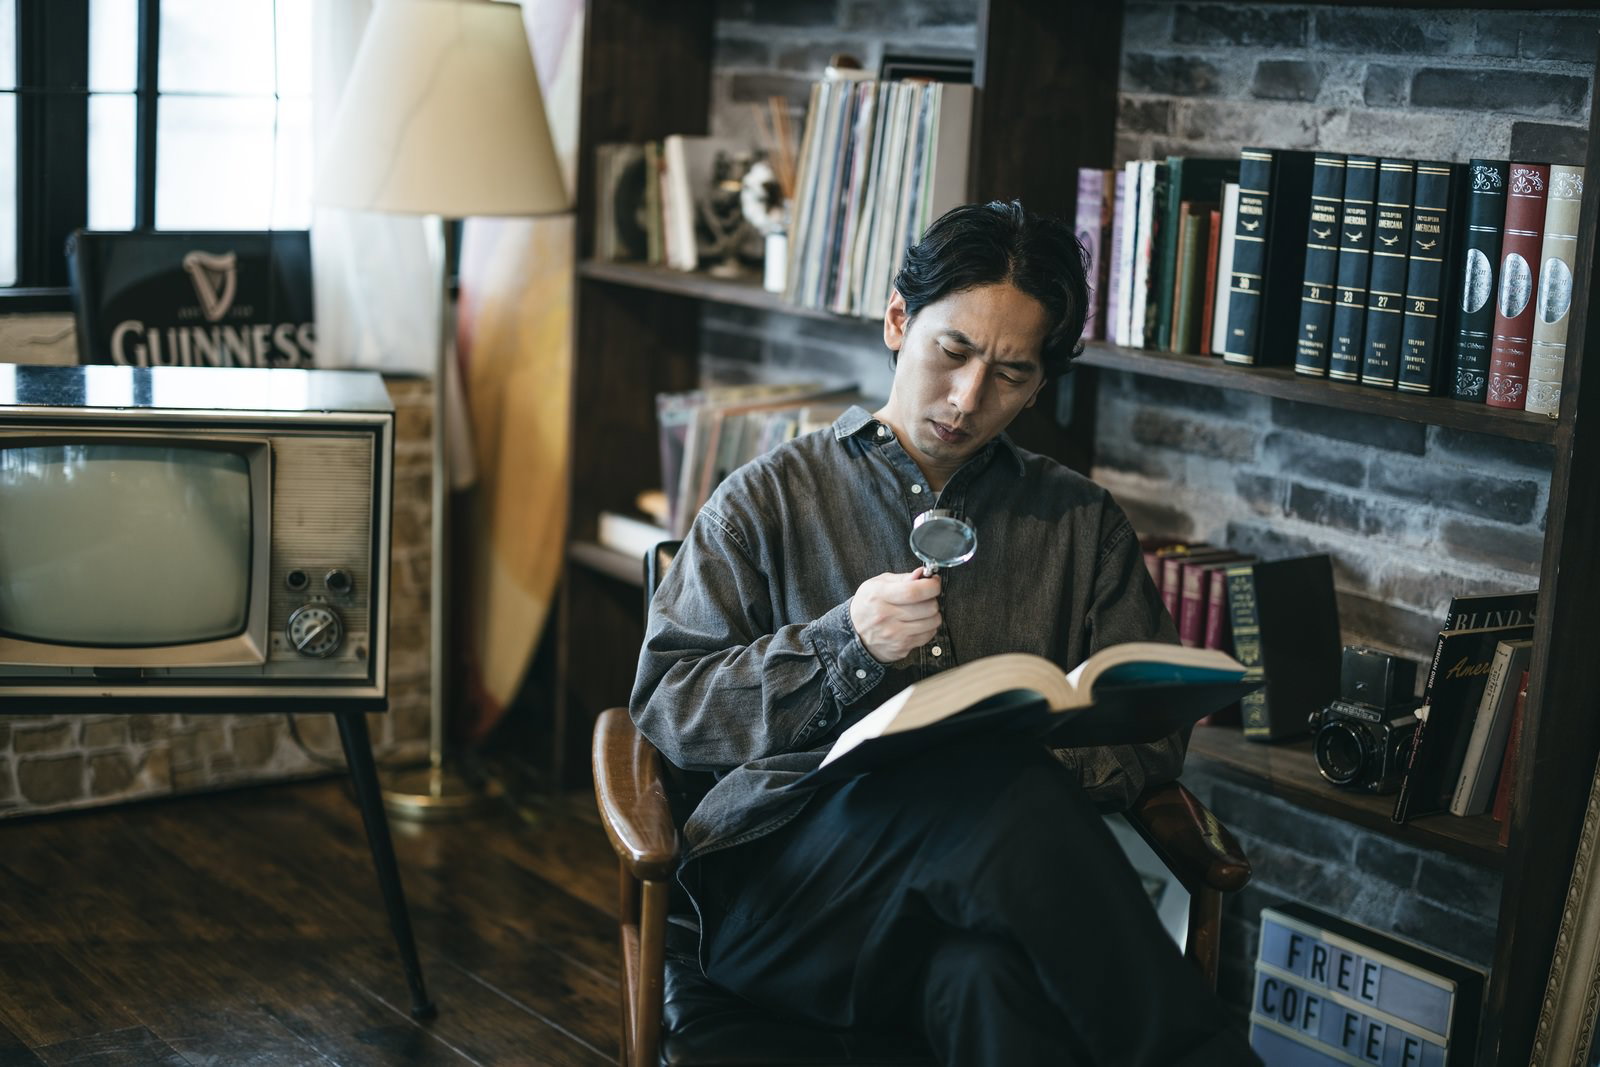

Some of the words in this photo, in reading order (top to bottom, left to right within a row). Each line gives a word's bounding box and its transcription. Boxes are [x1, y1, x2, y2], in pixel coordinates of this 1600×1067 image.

[1378, 218, 1403, 230] AMERICANA
[1414, 222, 1440, 234] AMERICANA
[1310, 286, 1320, 299] 21
[1343, 290, 1353, 303] 23
[1378, 295, 1389, 308] 27
[1414, 300, 1425, 313] 26
[111, 319, 317, 367] GUINNESS
[1432, 639, 1444, 671] AMERICAN
[1446, 655, 1491, 680] Amer
[1427, 670, 1436, 689] DINER
[1288, 934, 1377, 1001] FREE
